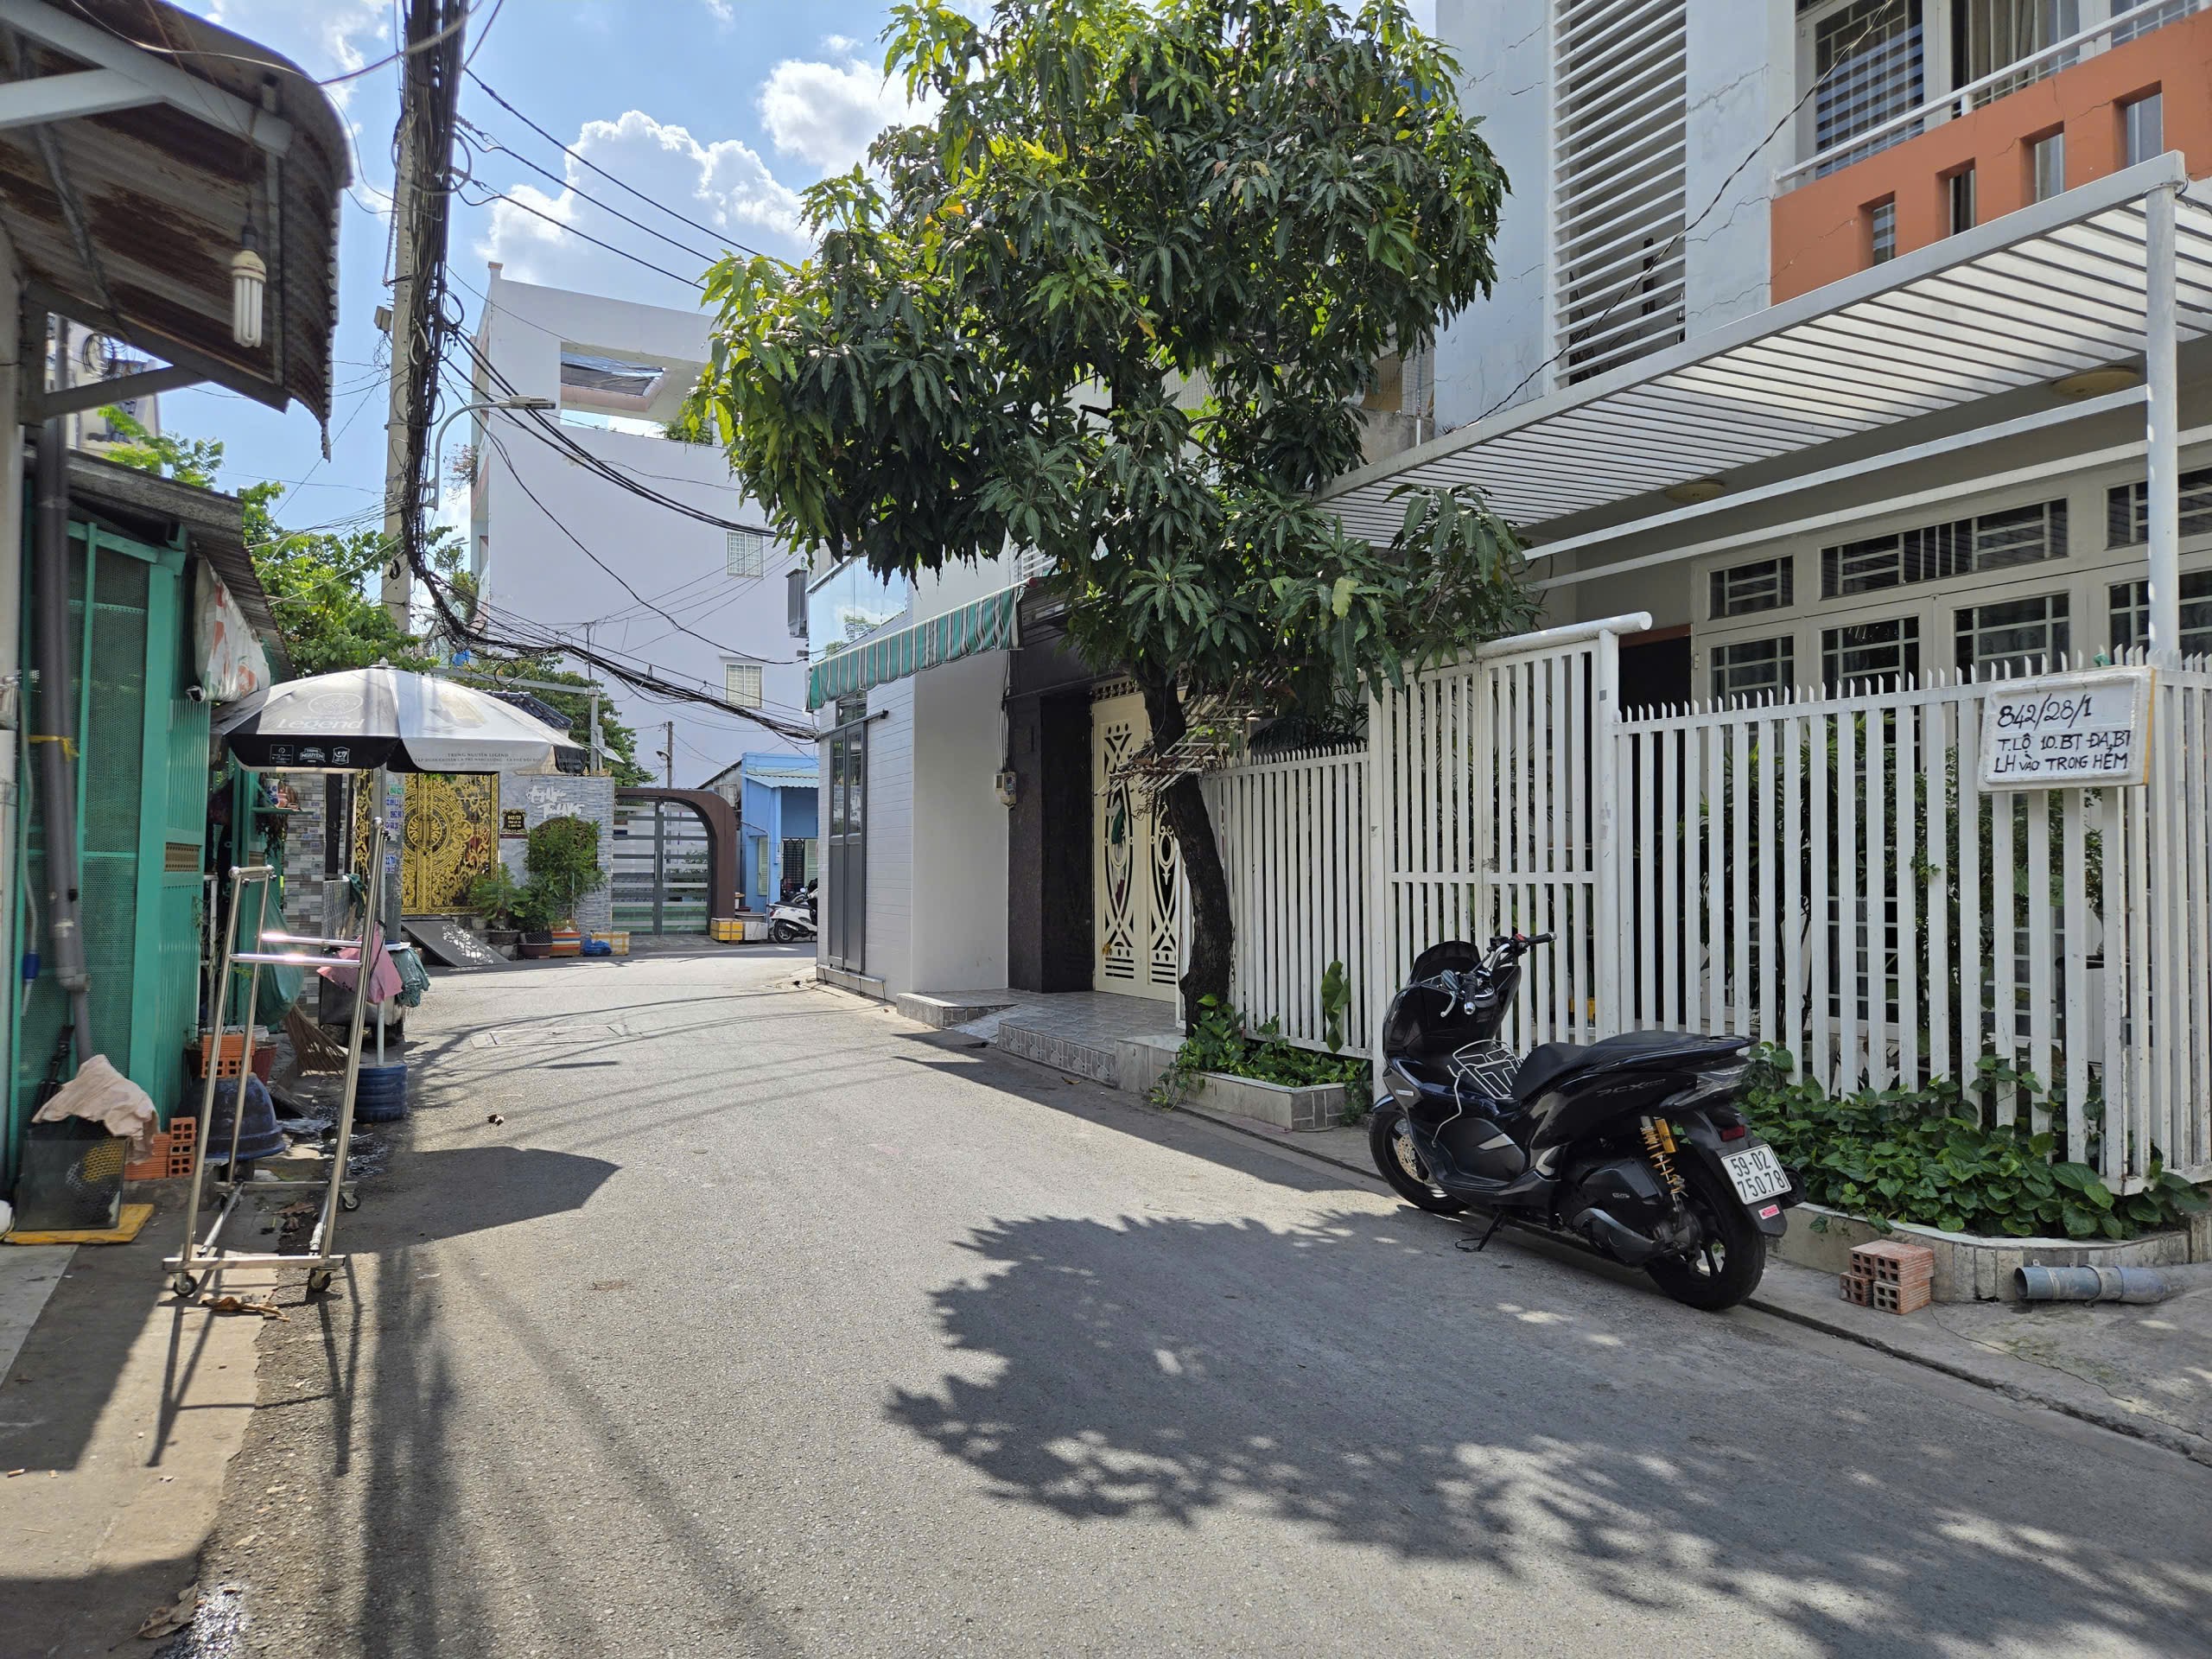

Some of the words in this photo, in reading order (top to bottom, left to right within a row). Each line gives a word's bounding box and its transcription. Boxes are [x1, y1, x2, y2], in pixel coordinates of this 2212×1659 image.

[1998, 693, 2092, 731] 842/28/1
[1994, 754, 2016, 772] LH
[2044, 755, 2088, 771] TRONG
[1737, 1170, 1786, 1200] 750.78
